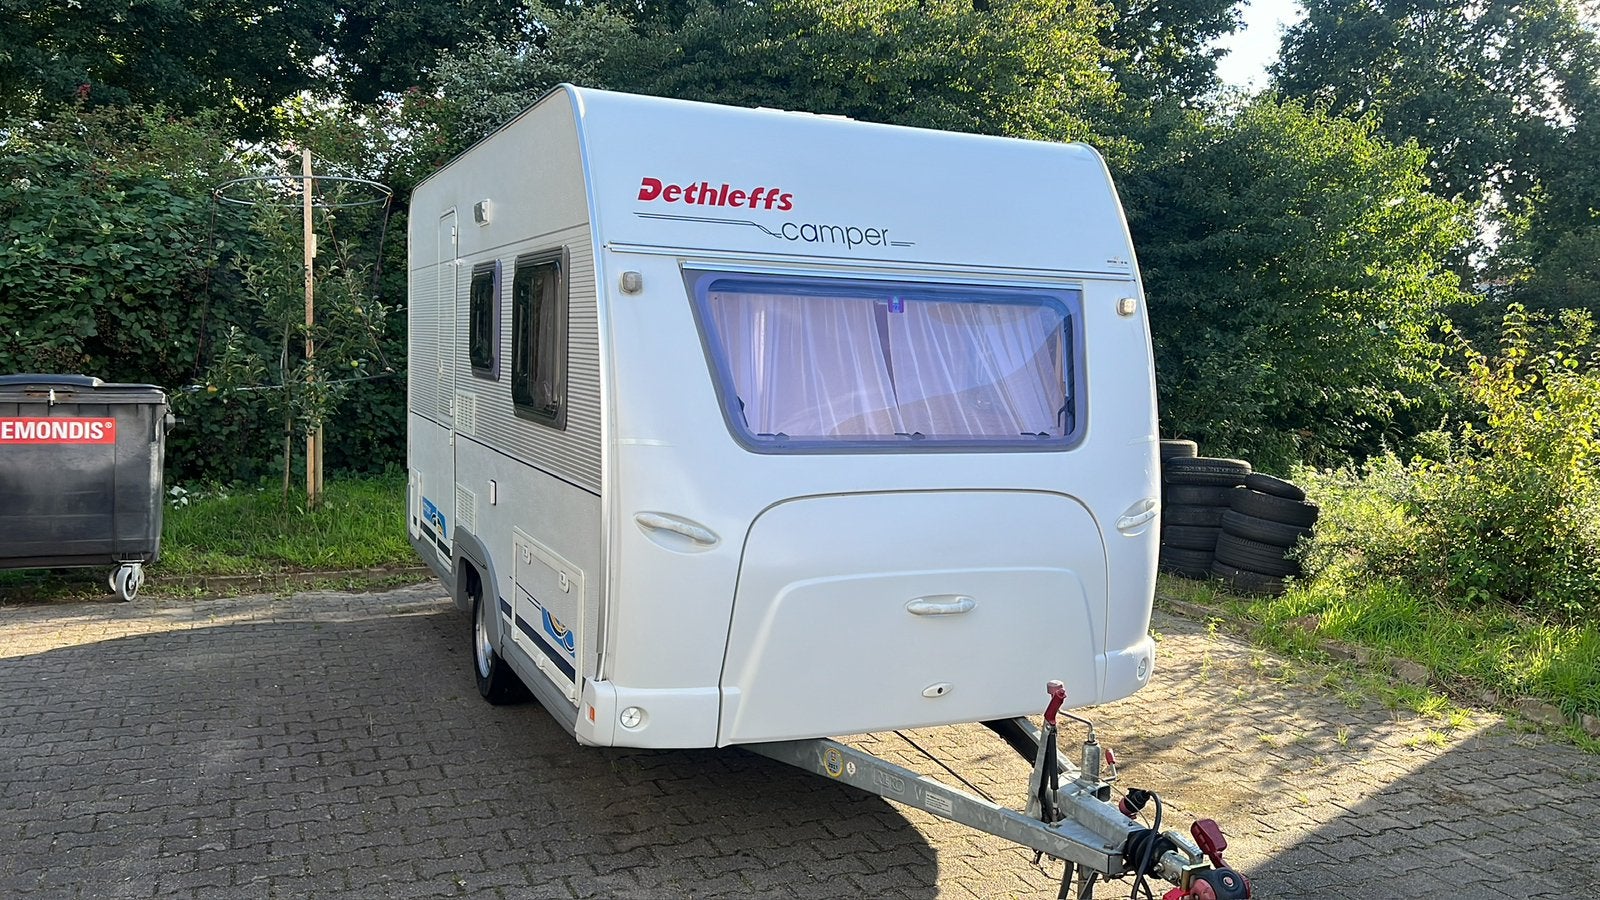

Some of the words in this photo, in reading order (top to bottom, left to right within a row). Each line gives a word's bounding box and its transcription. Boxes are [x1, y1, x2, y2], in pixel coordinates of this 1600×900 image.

[637, 177, 794, 211] Dethleffs
[781, 222, 889, 250] camper
[1, 421, 104, 439] EMONDIS
